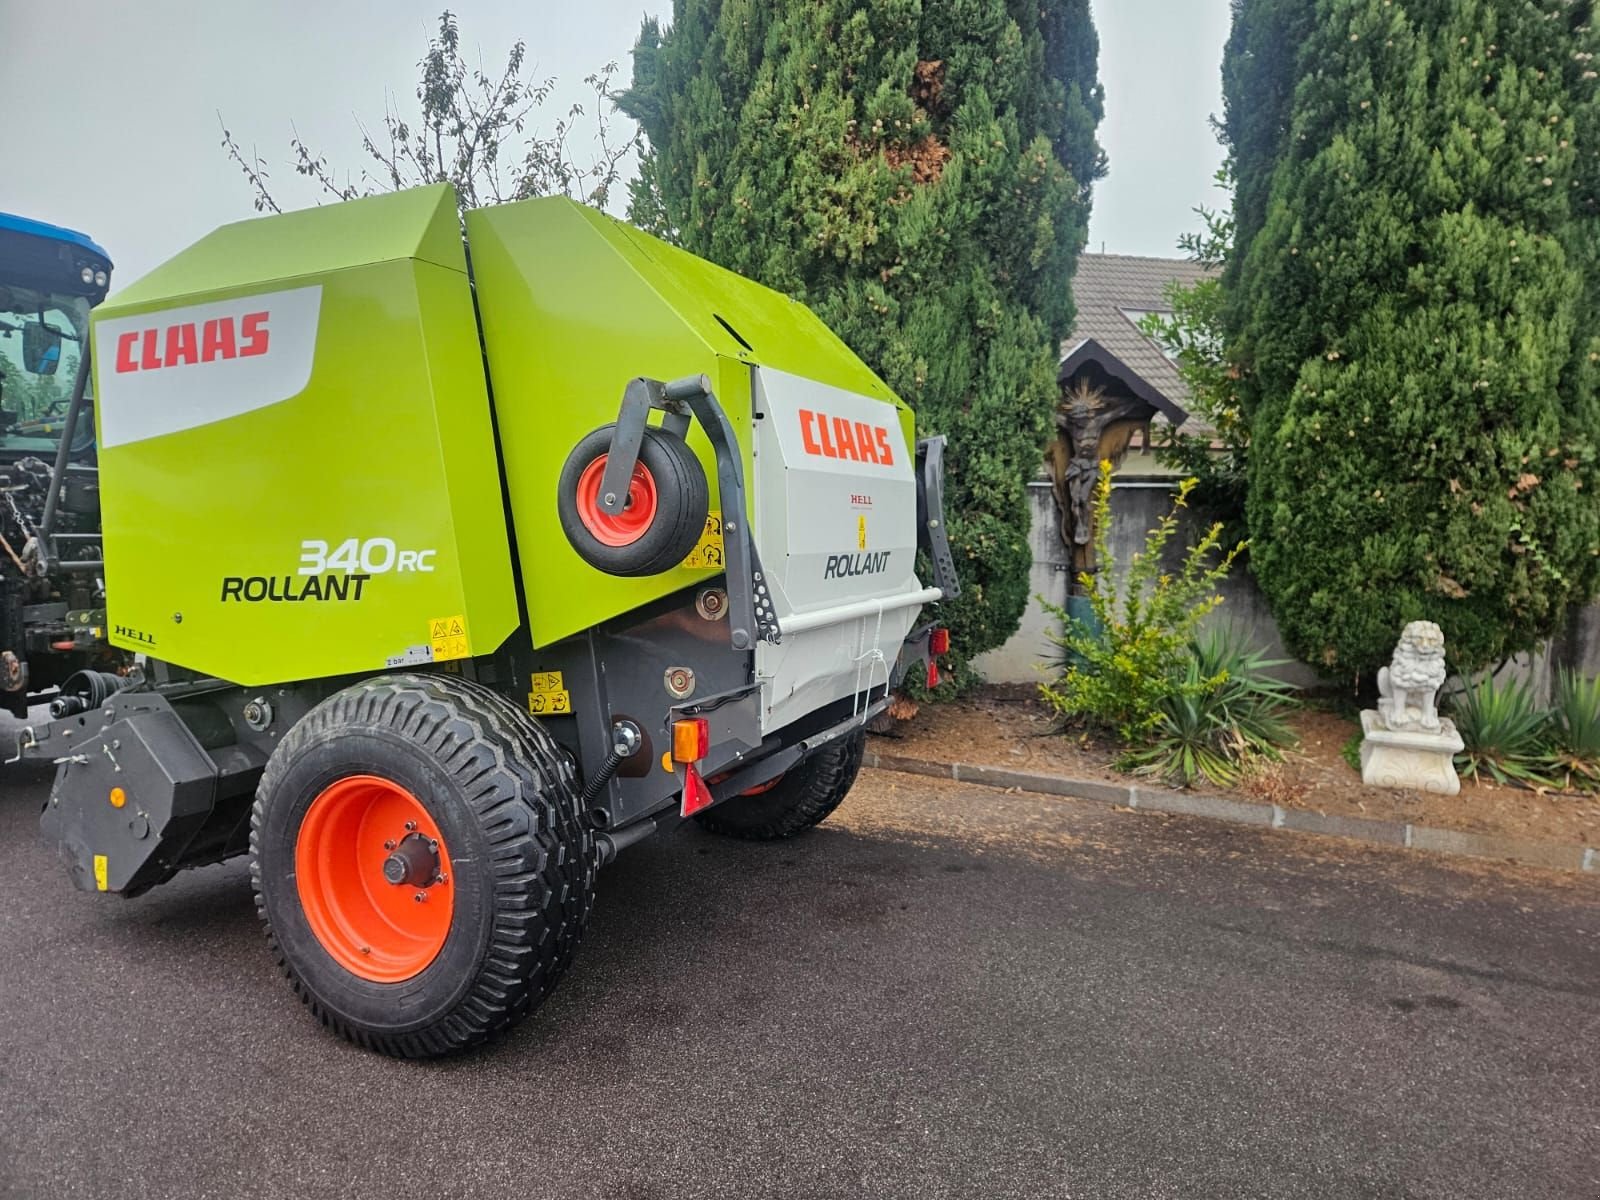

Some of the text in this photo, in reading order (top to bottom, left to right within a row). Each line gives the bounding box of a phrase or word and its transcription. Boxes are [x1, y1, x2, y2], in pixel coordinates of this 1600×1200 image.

[116, 311, 270, 373] CLAAS
[799, 409, 893, 466] CLAAS
[850, 494, 872, 505] HELL
[824, 551, 891, 580] ROLLANT
[221, 574, 371, 602] ROLLANT
[115, 624, 157, 645] HELL
